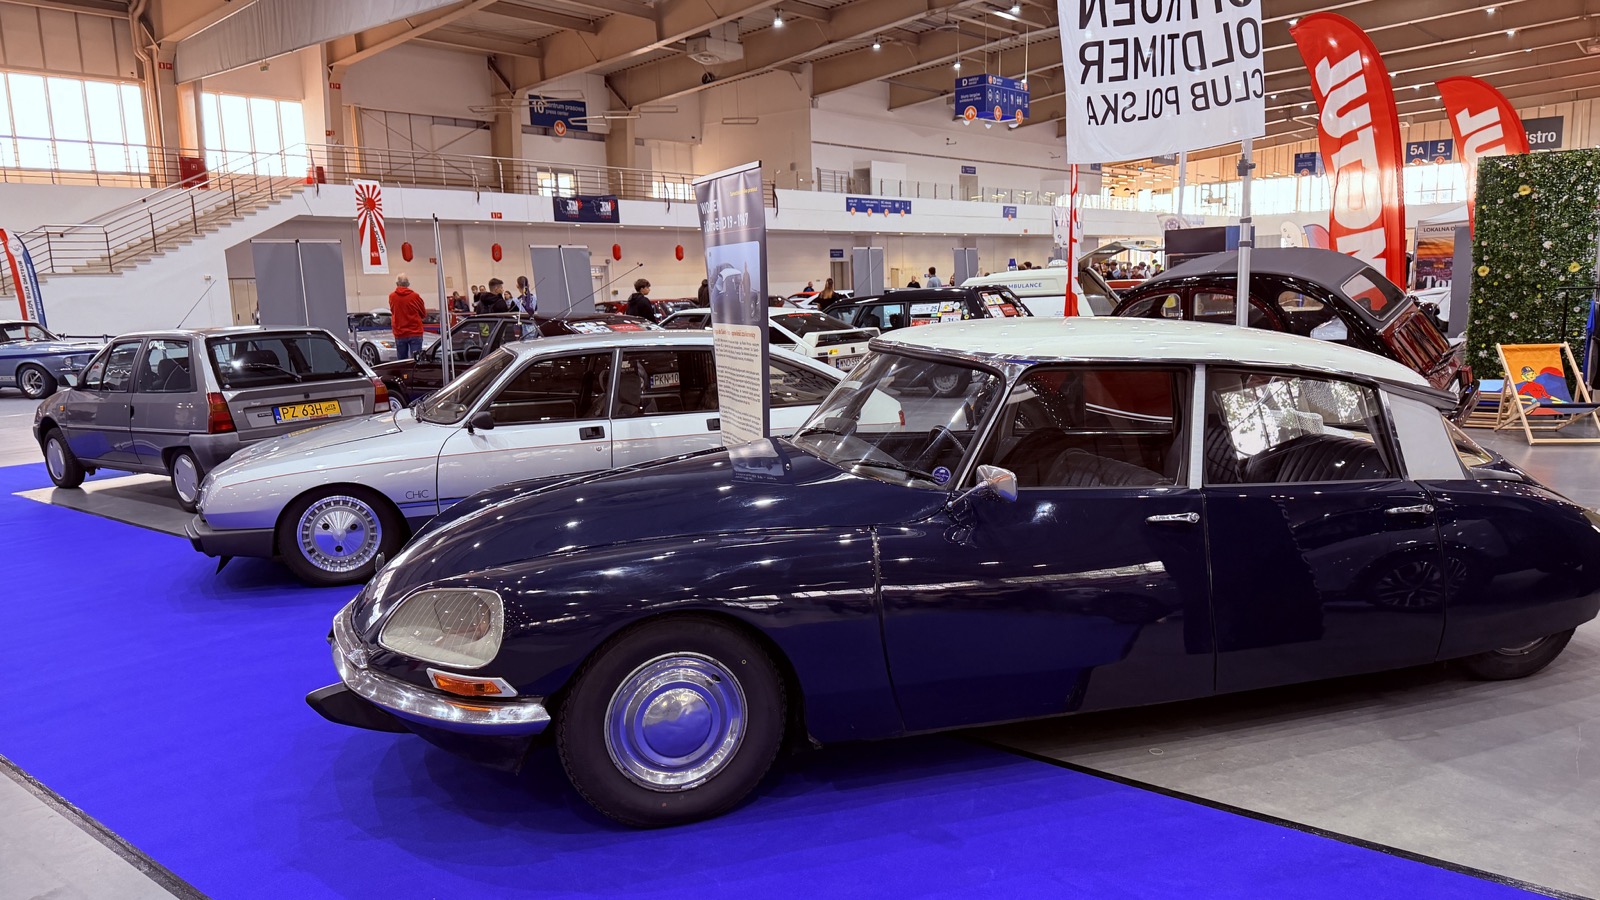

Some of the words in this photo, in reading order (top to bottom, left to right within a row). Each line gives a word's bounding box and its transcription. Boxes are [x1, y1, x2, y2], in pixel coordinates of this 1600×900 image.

[1525, 132, 1557, 145] istro
[1410, 144, 1424, 156] 5A
[1437, 142, 1446, 153] 5
[281, 406, 298, 419] PZ
[301, 403, 324, 417] 63H
